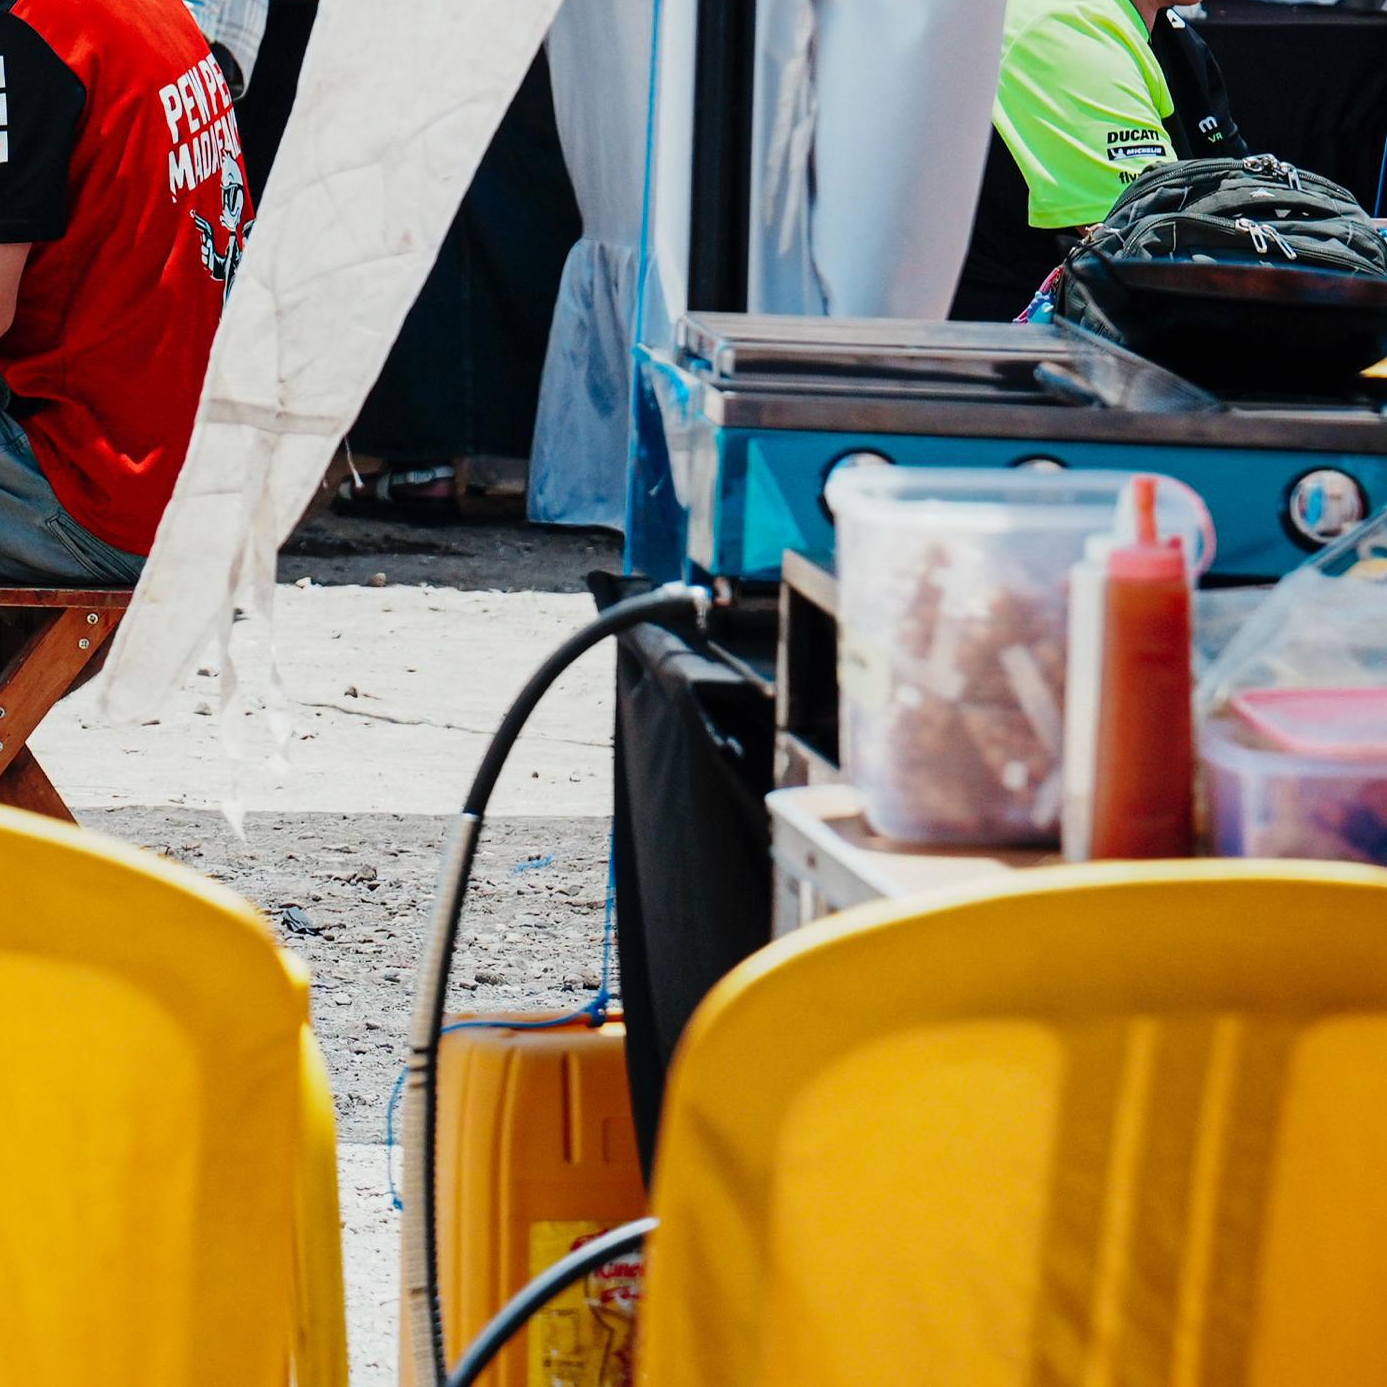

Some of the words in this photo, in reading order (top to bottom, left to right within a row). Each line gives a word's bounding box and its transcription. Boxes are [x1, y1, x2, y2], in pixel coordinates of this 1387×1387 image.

[158, 66, 211, 144] PEW
[1107, 129, 1160, 144] DUCATI
[1126, 147, 1162, 155] MICHELIN
